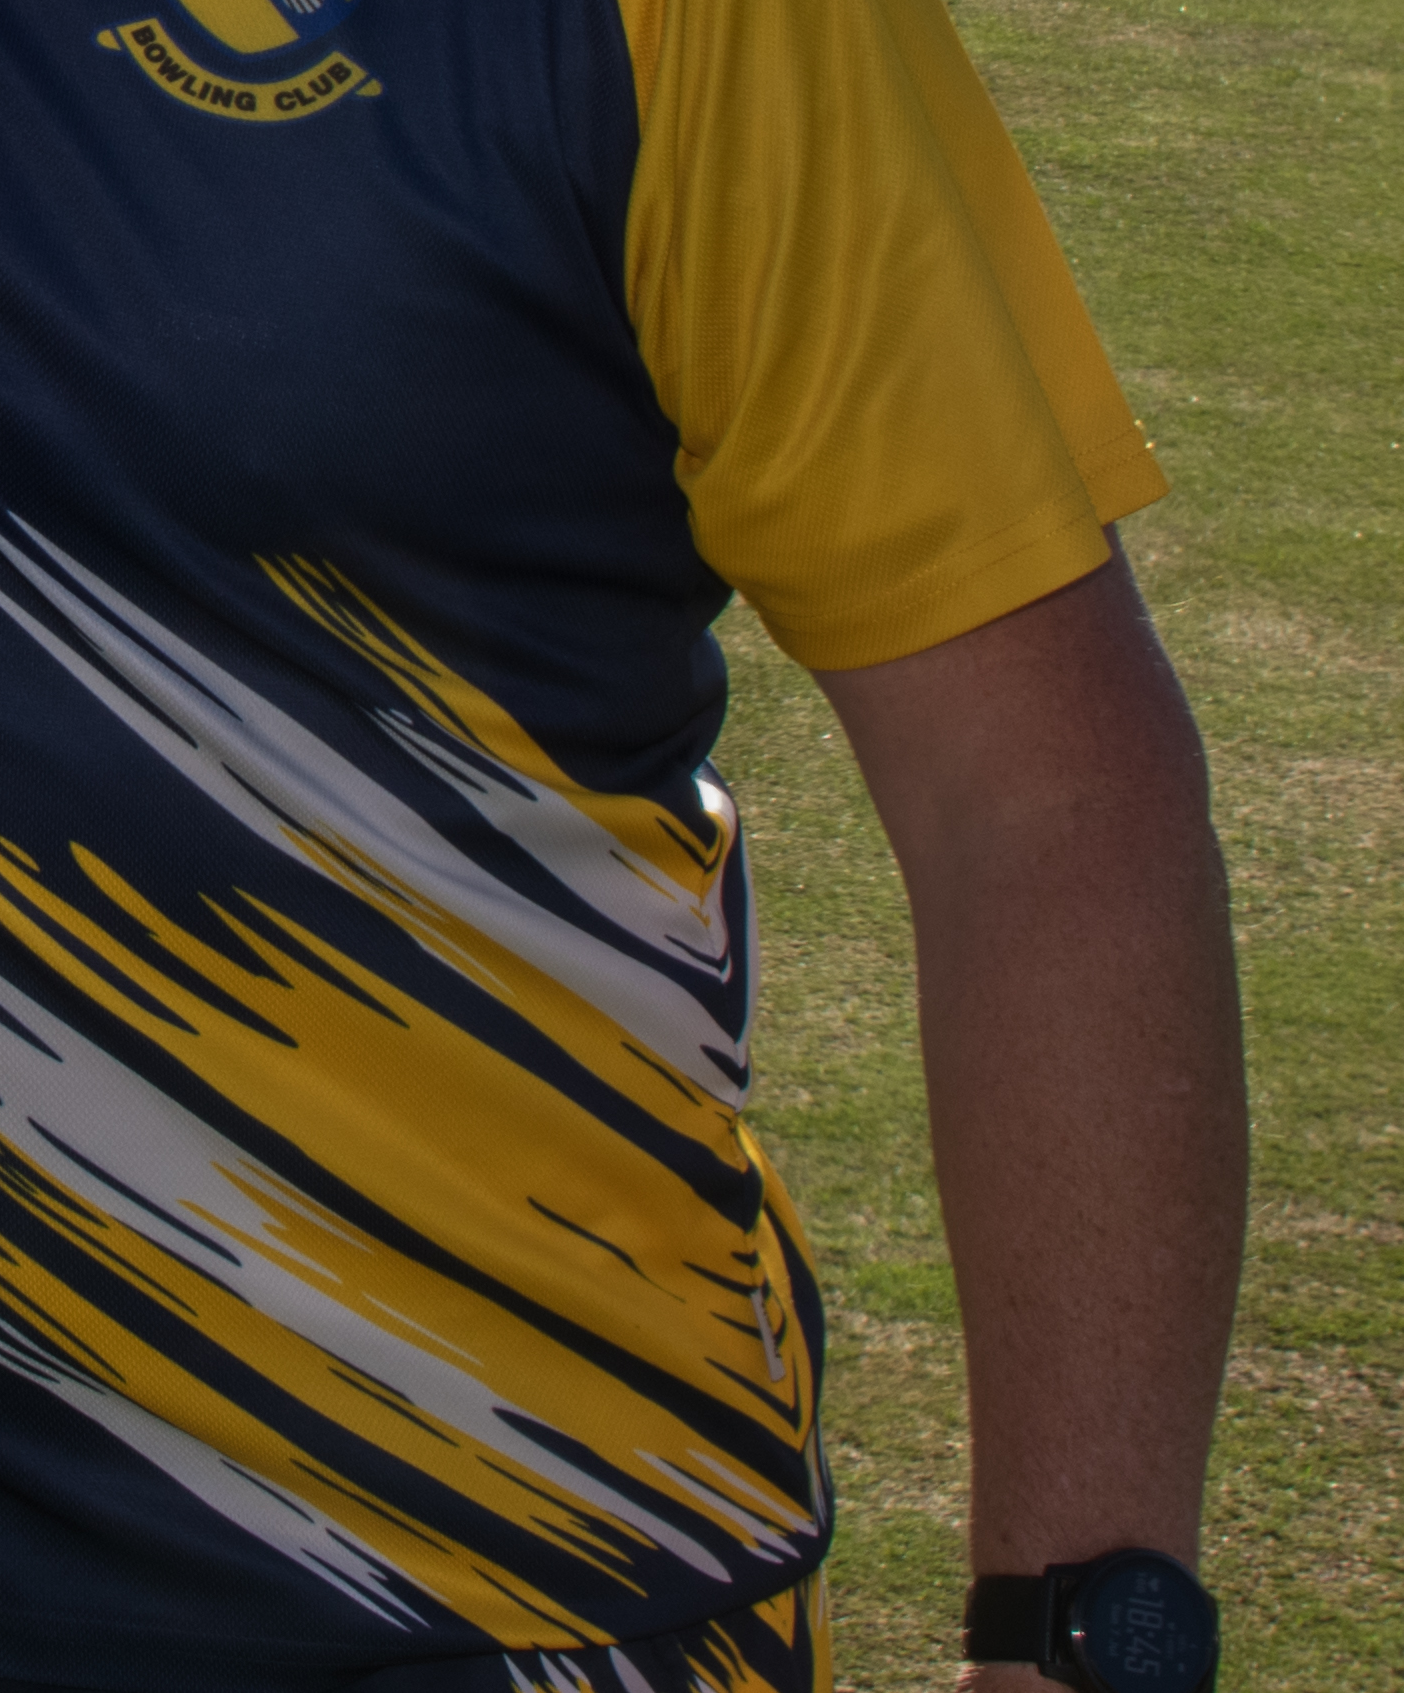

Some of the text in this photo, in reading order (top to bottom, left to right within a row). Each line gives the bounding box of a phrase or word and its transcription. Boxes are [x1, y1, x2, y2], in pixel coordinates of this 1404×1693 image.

[131, 24, 354, 112] BOWLING CLUB
[1124, 1597, 1165, 1677] 18:45
